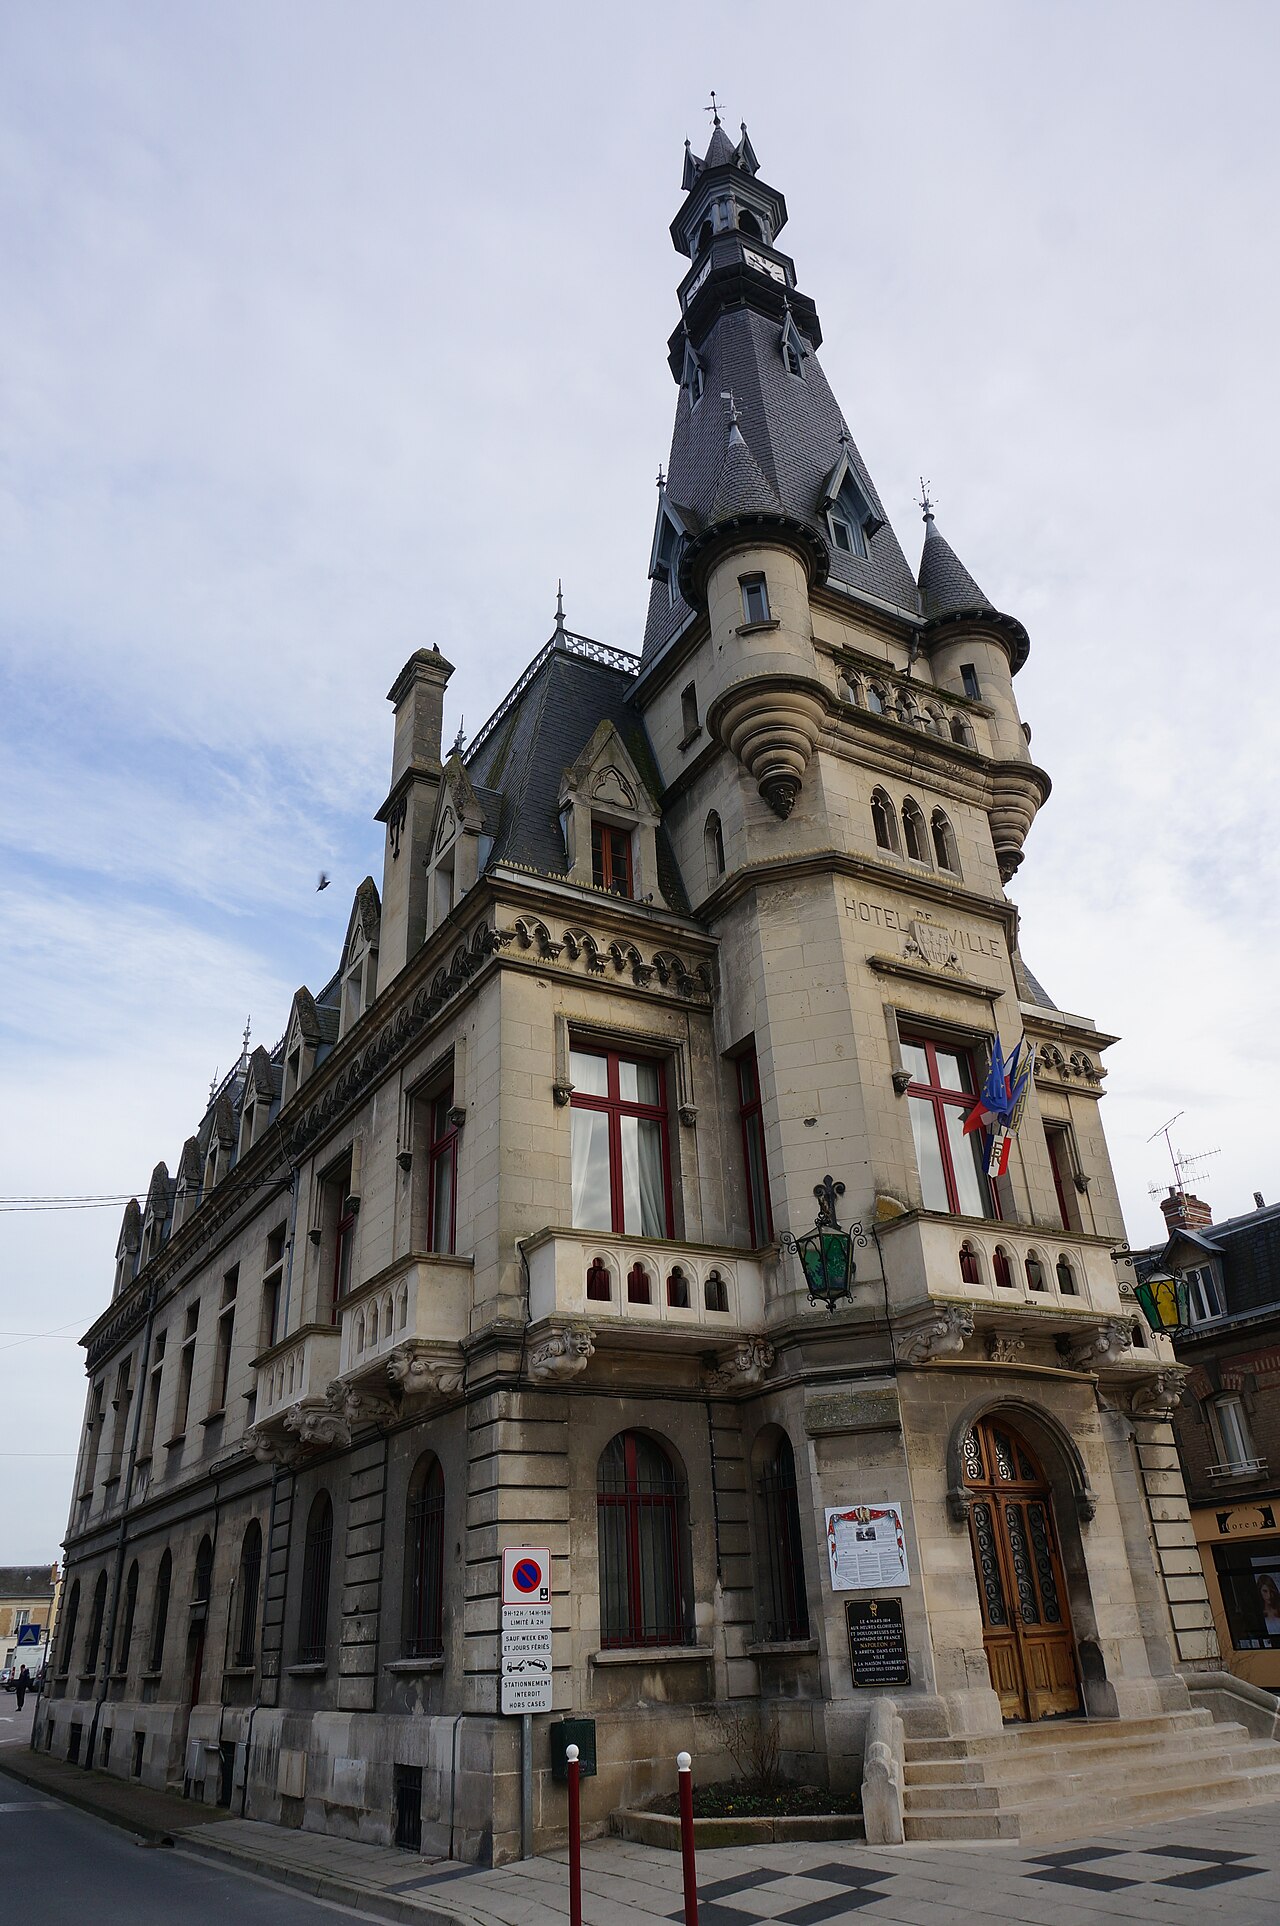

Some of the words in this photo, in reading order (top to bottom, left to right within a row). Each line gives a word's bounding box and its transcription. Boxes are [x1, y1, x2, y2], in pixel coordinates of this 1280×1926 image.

[843, 897, 909, 933] HOTEL
[948, 929, 1003, 959] VILLE
[512, 1644, 530, 1652] JOURS
[504, 1680, 550, 1688] STATIONNEMENT
[514, 1690, 541, 1698] INTERDIT
[509, 1701, 526, 1709] HORS
[527, 1700, 546, 1708] CASES
